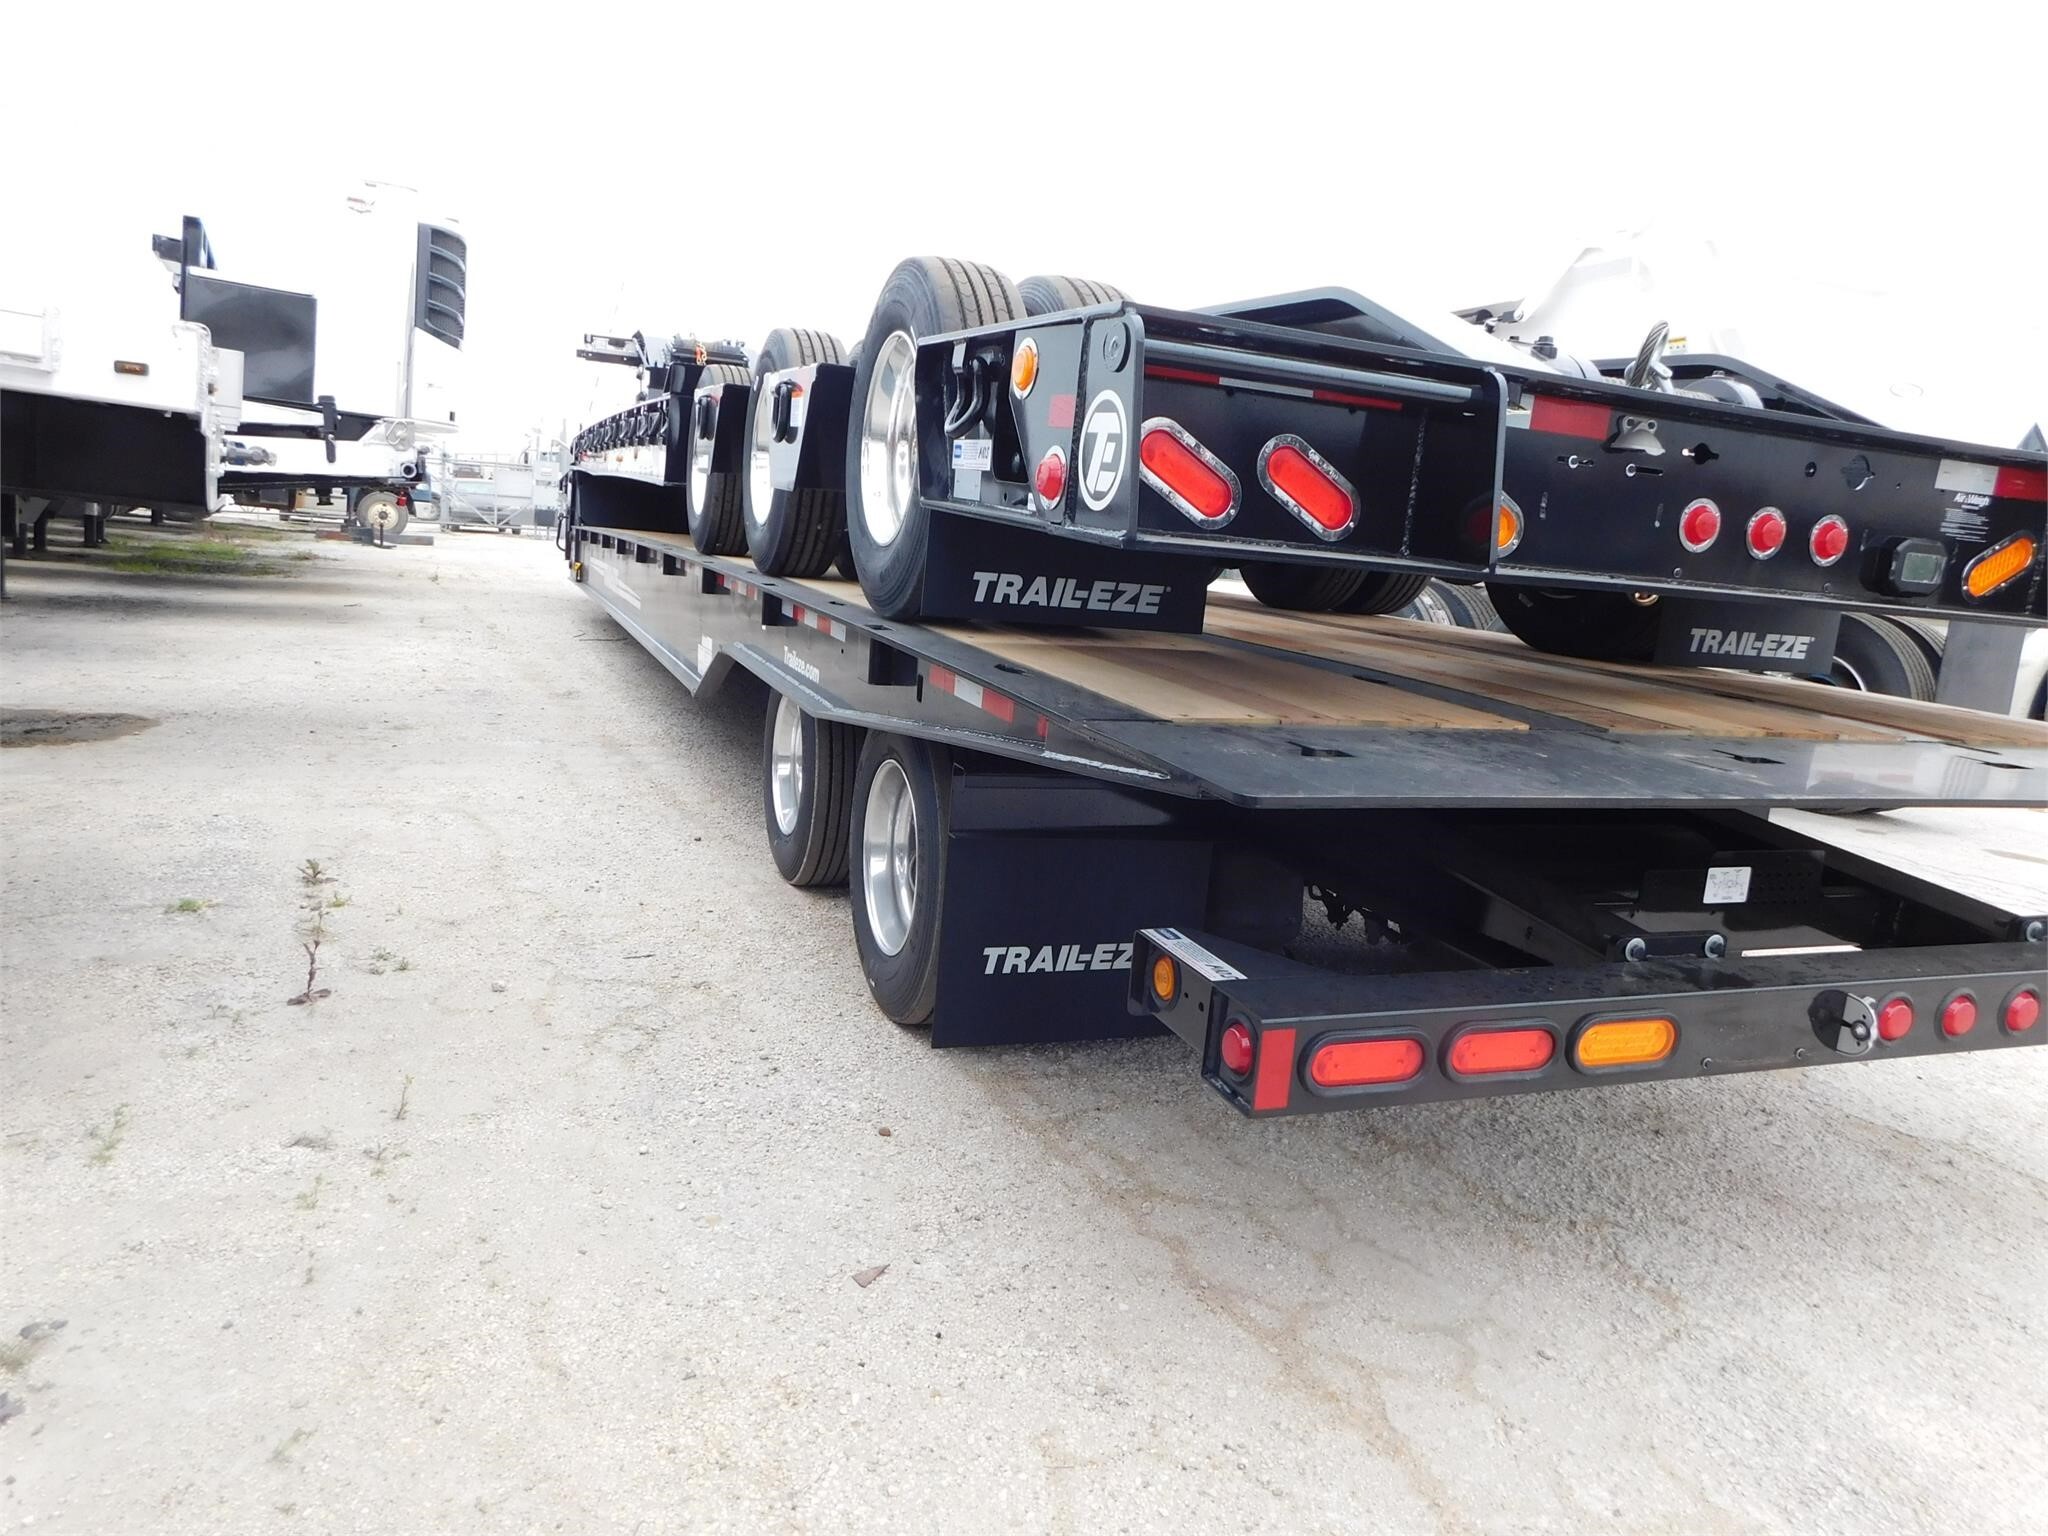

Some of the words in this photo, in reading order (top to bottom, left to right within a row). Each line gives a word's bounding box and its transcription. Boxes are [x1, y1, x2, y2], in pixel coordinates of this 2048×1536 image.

[973, 571, 1165, 614] TRAIL-EZE
[1689, 628, 1812, 659] TRAIL-EZE
[983, 942, 1133, 975] TRAIL-EZ
